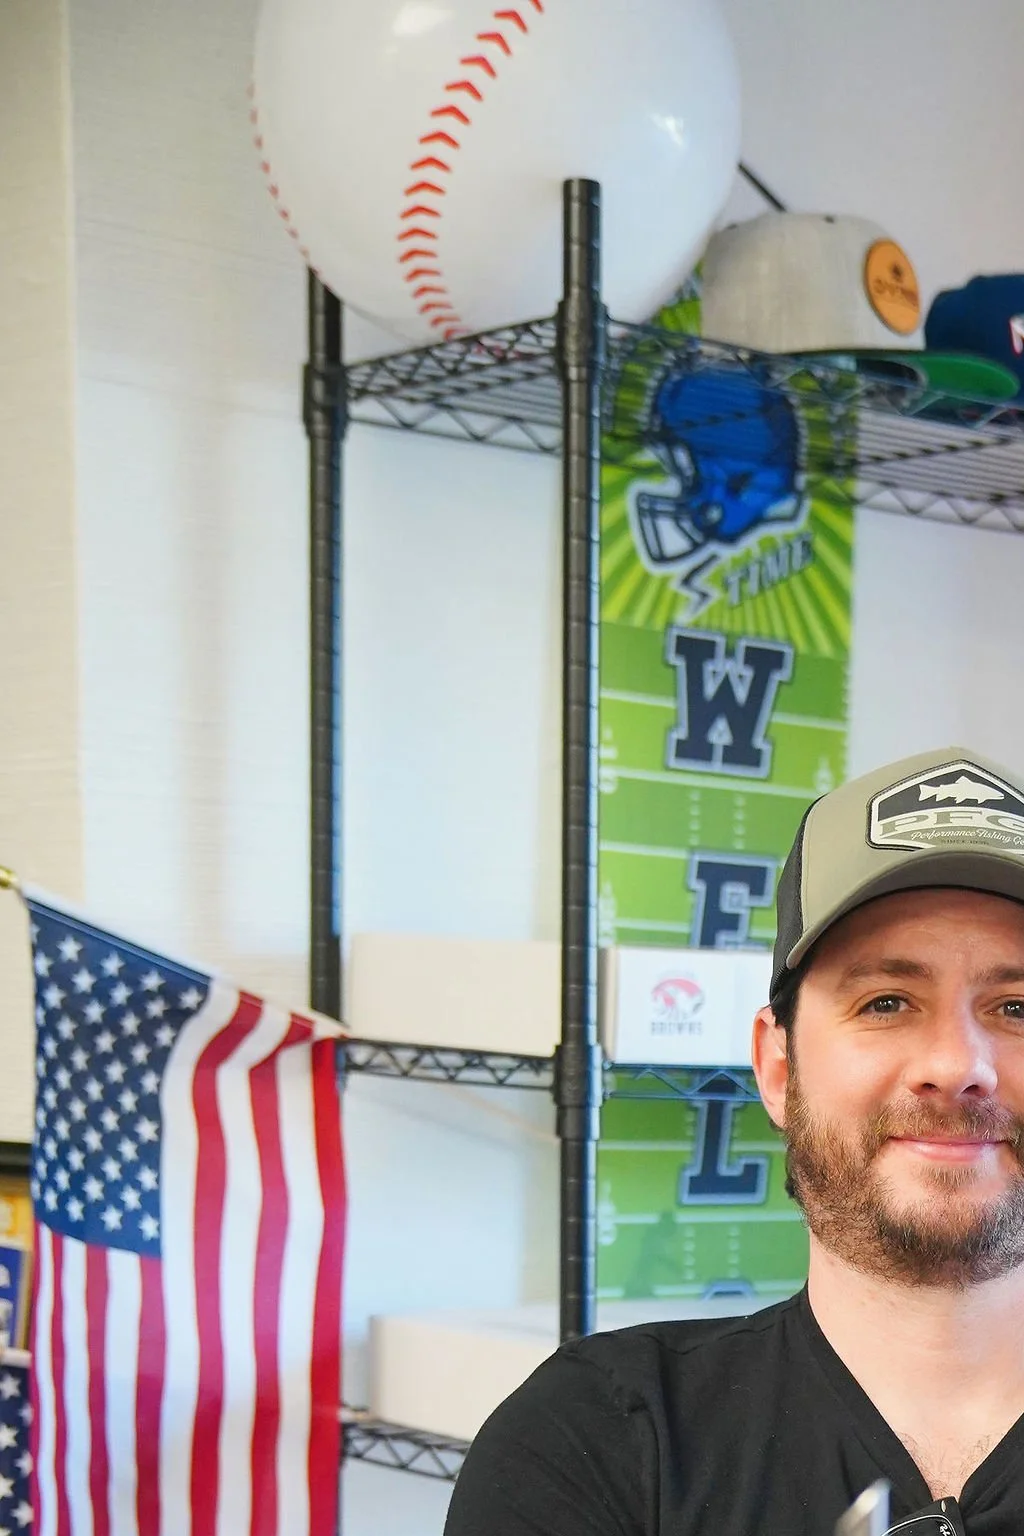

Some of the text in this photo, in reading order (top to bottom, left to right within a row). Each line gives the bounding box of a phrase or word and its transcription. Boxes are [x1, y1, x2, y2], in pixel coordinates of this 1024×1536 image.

[722, 532, 812, 608] TIME
[910, 828, 976, 841] Performance
[975, 828, 1012, 843] Fishing
